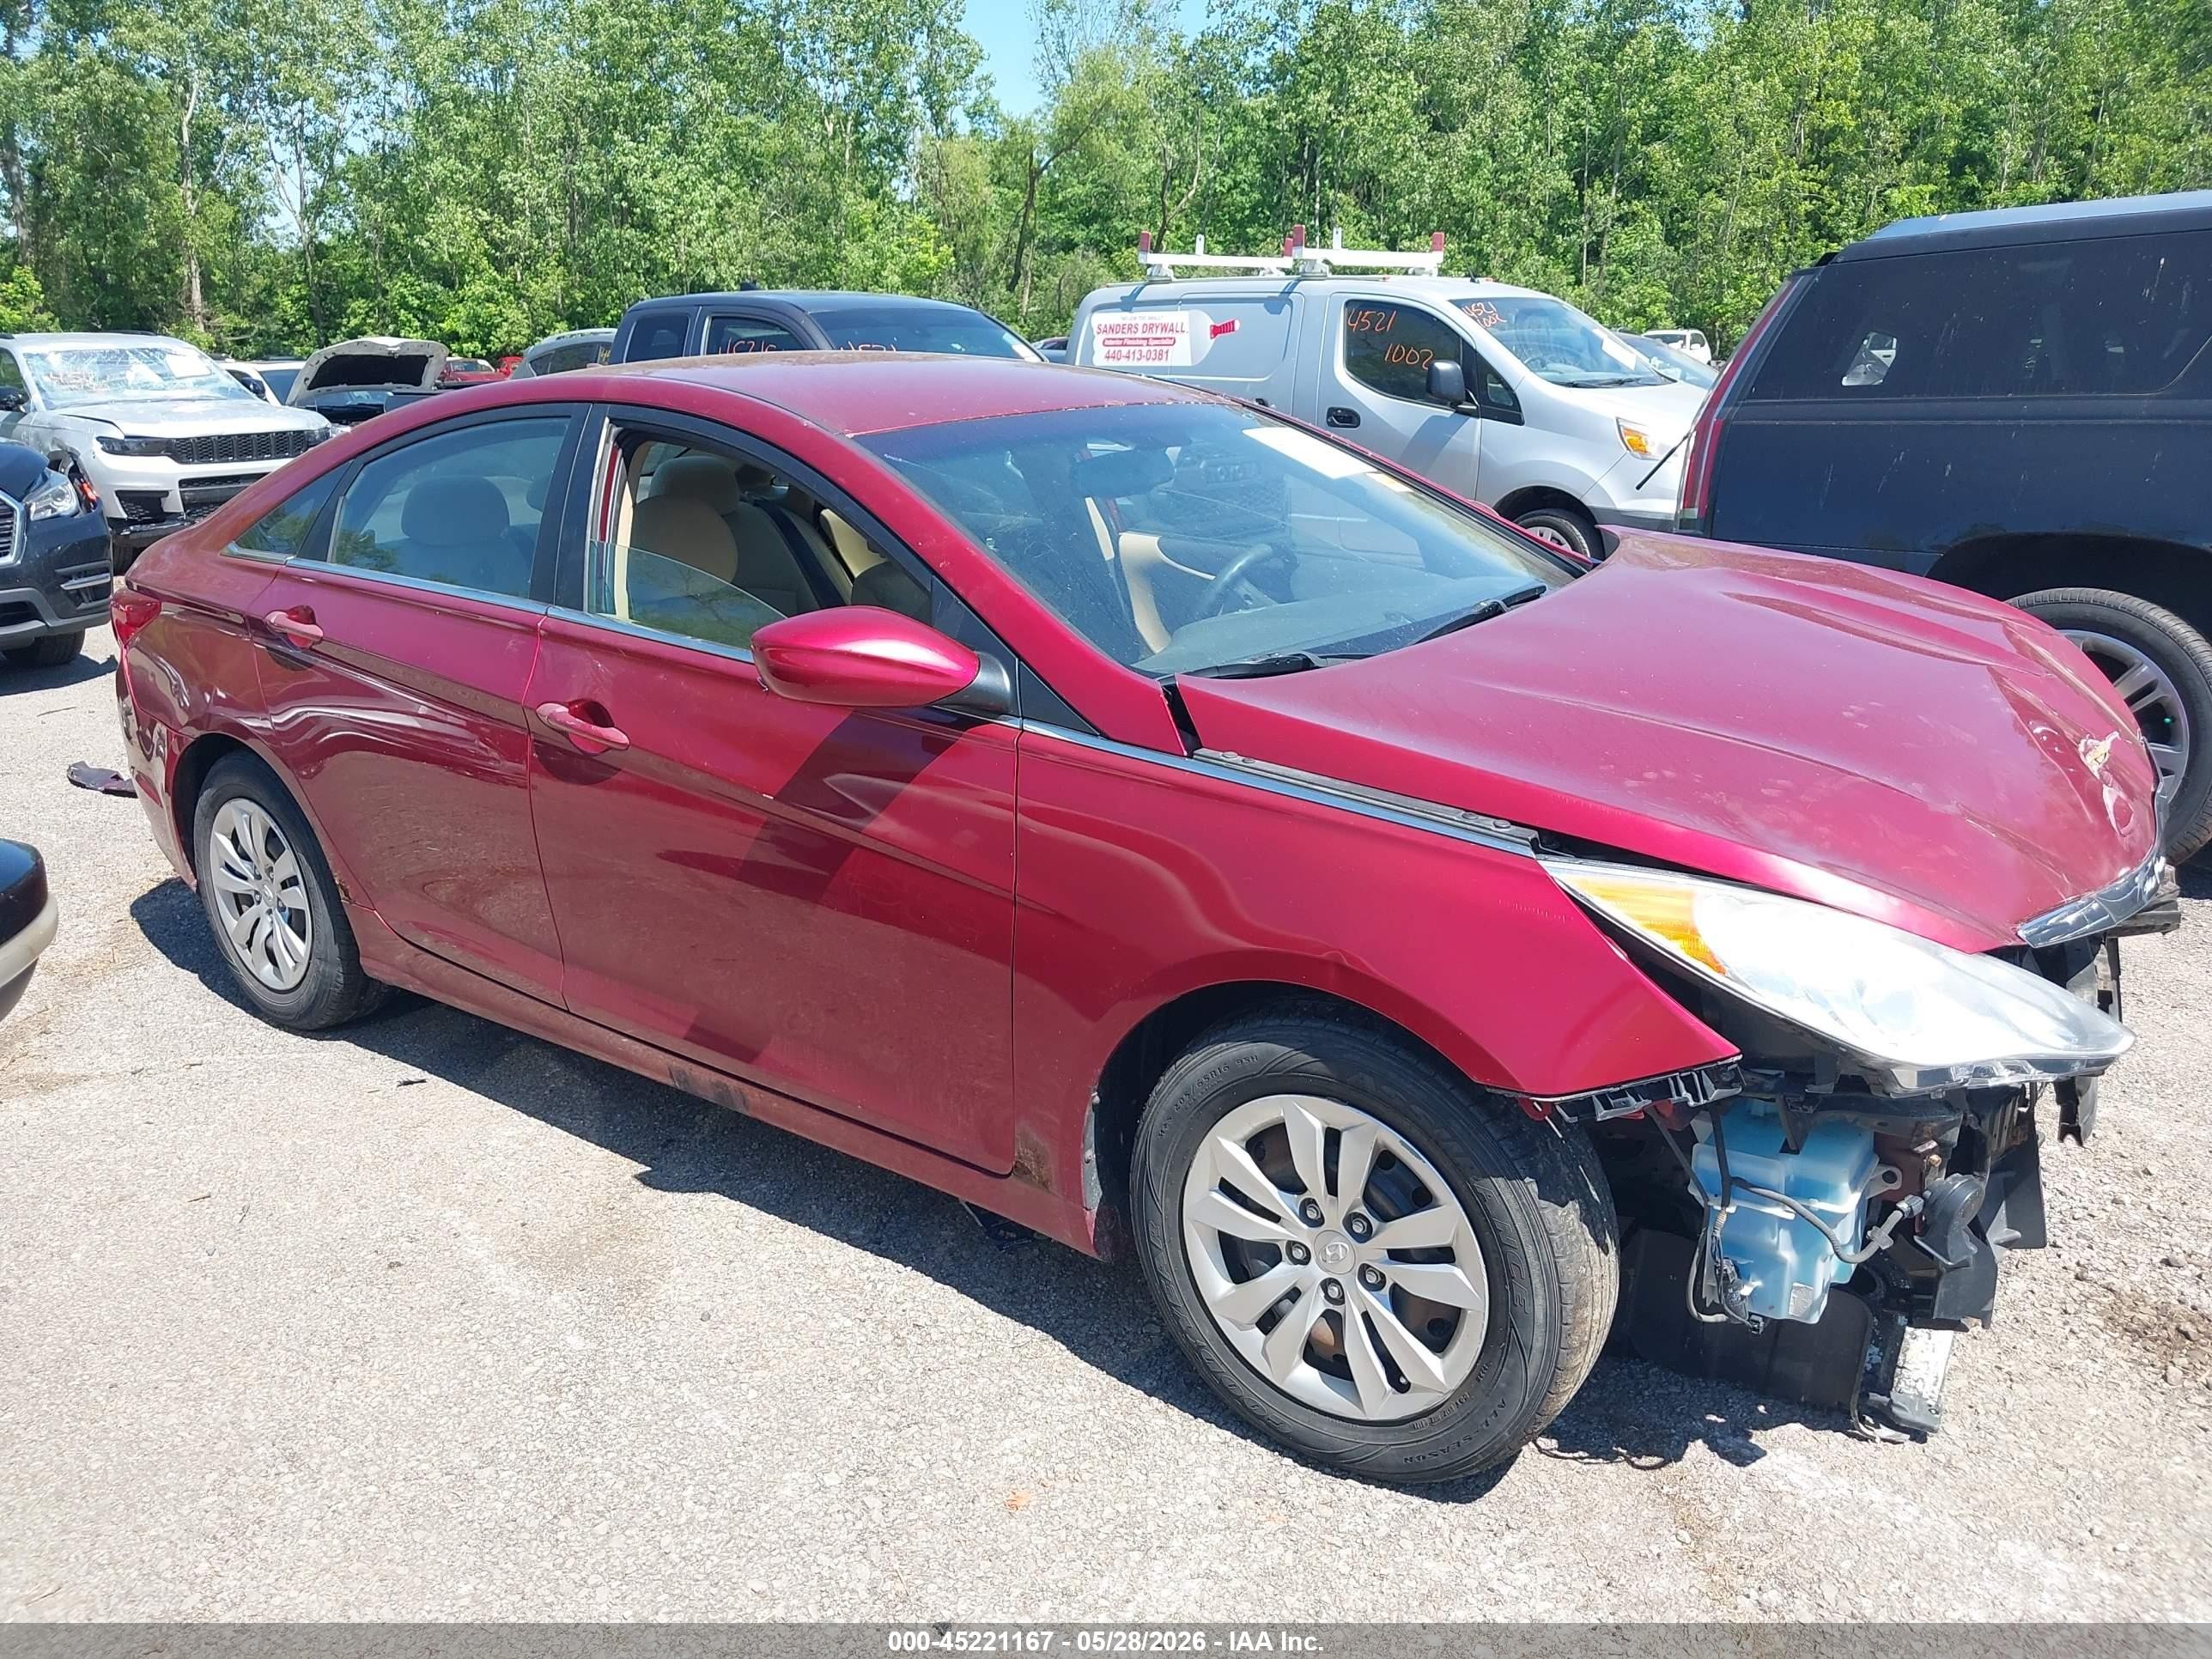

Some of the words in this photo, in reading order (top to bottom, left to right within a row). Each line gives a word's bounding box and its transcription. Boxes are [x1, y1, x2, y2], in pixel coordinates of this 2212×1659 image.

[1462, 301, 1497, 317] 4521
[1347, 307, 1397, 332] 4521
[1097, 323, 1139, 335] SANDERS
[1104, 349, 1170, 361] 440-413-0381
[1384, 343, 1433, 370] 1002
